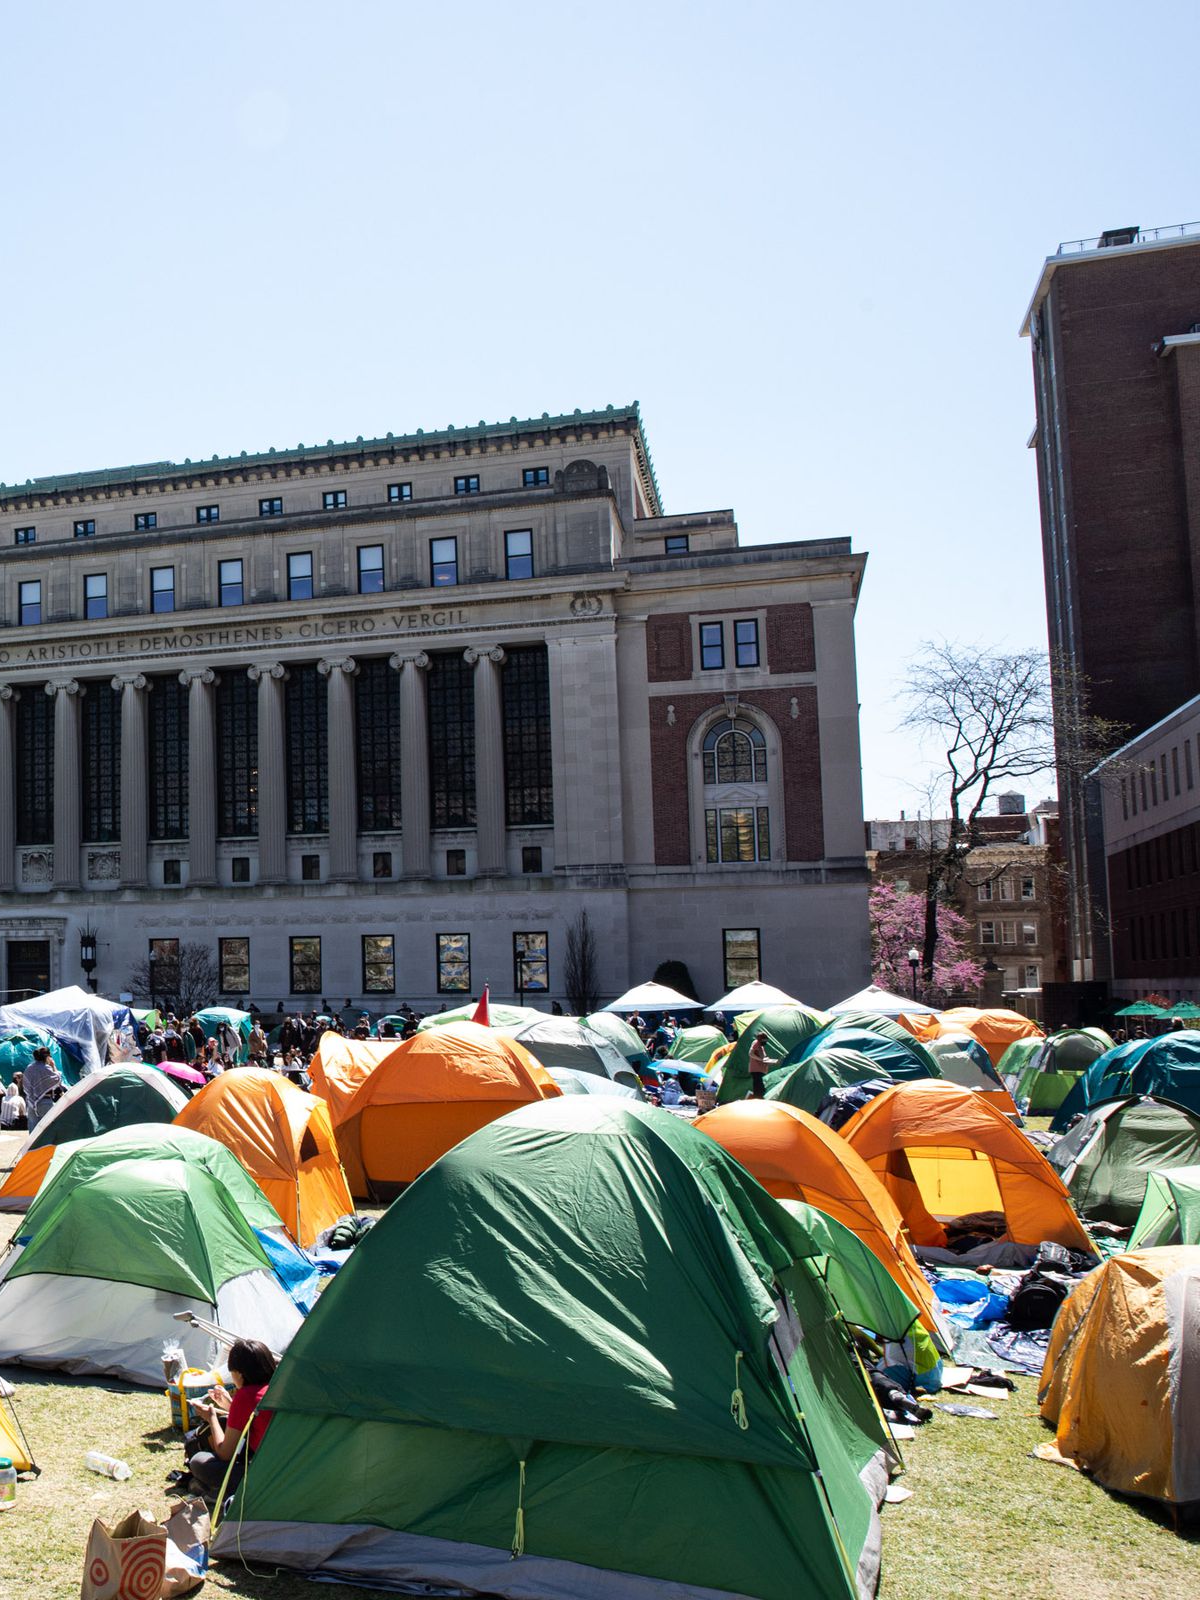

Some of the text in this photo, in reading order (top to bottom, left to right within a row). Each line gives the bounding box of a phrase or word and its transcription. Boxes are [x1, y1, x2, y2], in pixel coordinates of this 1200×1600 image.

[26, 640, 126, 661] ARISTOTLE
[140, 626, 283, 651] DEMOSTHENES
[299, 618, 376, 637] CICERO
[391, 610, 468, 629] VERGIL
